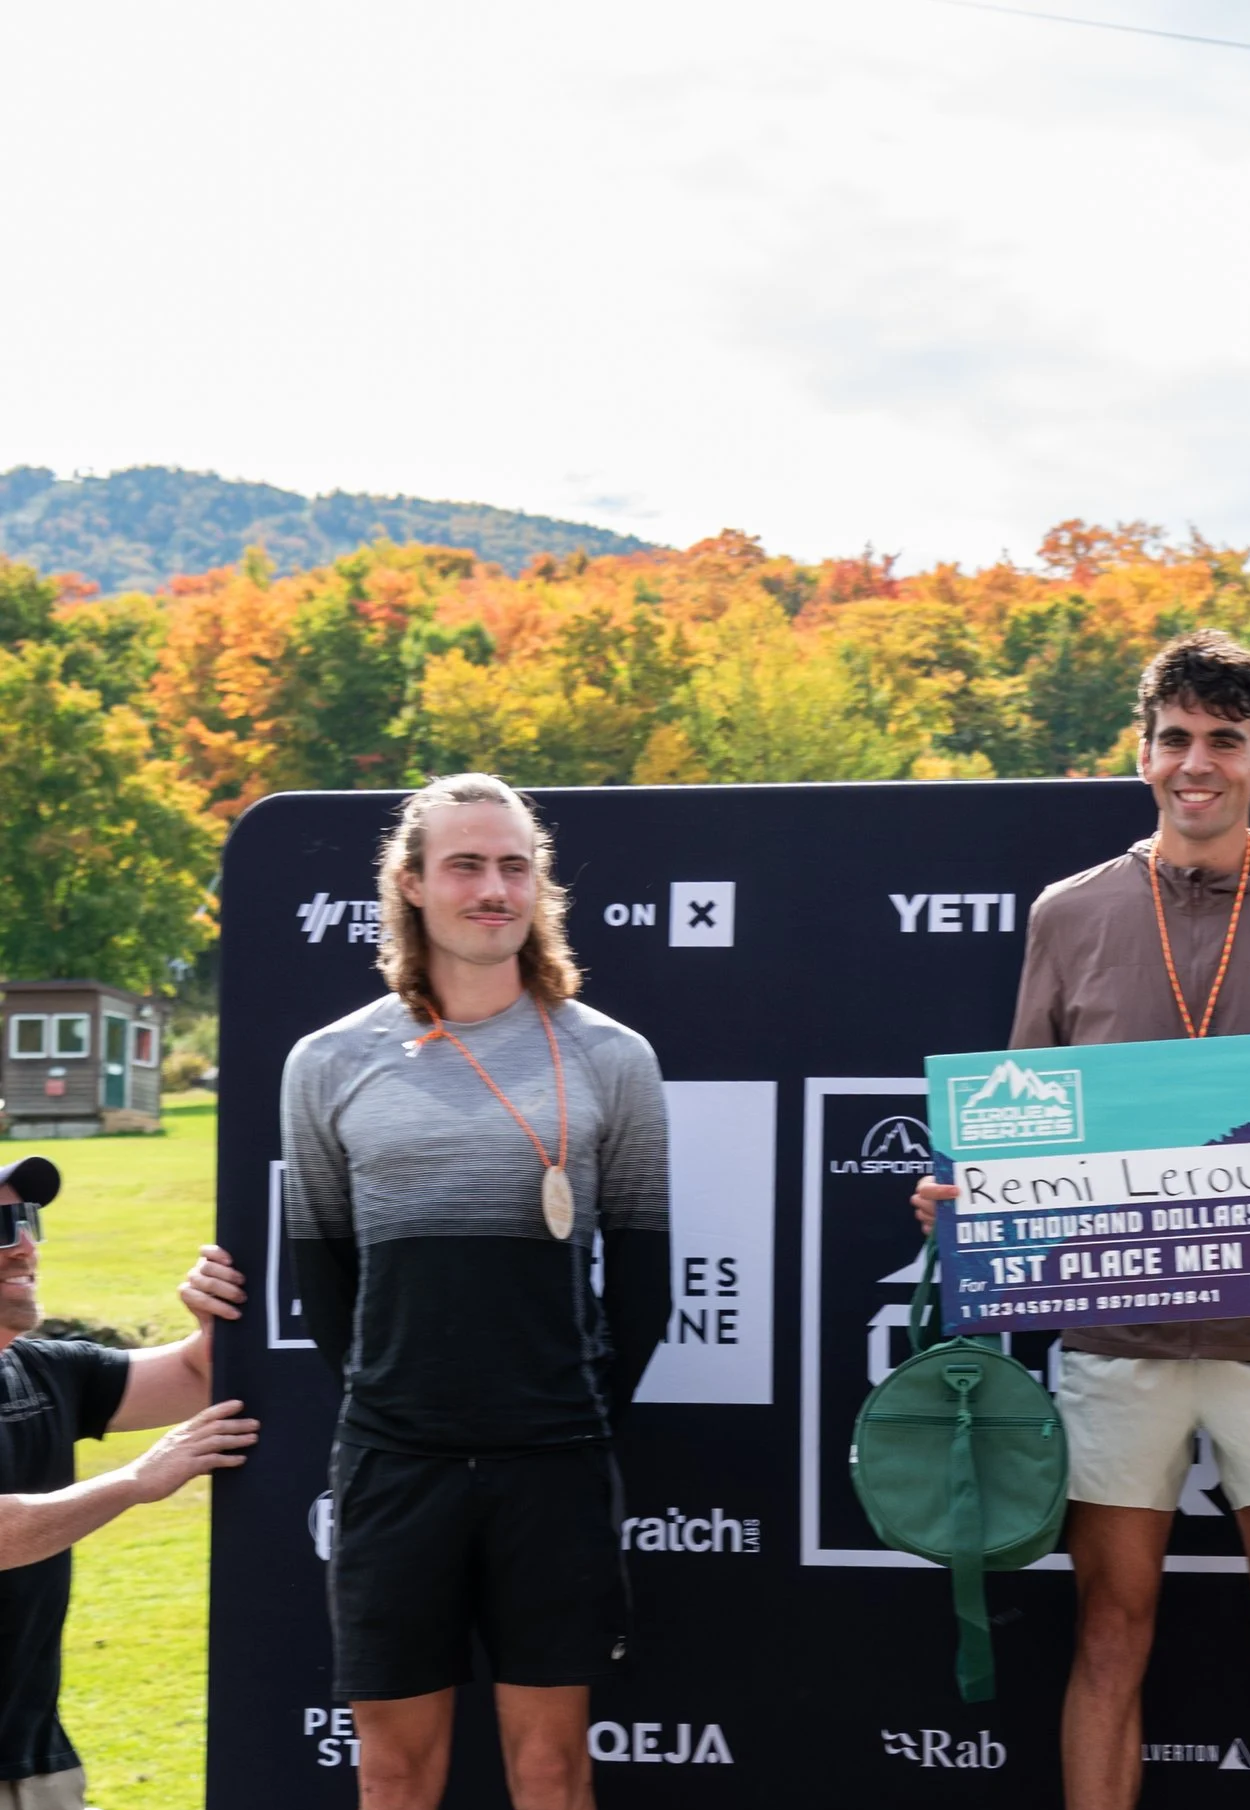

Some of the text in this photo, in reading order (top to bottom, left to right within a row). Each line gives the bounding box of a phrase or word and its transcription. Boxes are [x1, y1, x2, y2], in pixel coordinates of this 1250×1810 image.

[604, 904, 656, 926] ON
[889, 894, 1015, 932] YETI
[960, 1105, 1043, 1124] CIRQUE
[960, 1118, 1073, 1141] SERIES
[830, 1160, 935, 1174] LA SPORT
[965, 1160, 1094, 1205] Remi
[956, 1220, 1005, 1244] ONE
[1014, 1211, 1143, 1240] THOUSAND
[959, 1242, 1243, 1293] For 1ST PLACE MEN
[979, 1298, 1089, 1318] 123456789
[621, 1507, 743, 1552] ratch
[921, 1729, 1006, 1769] Rab
[1141, 1744, 1219, 1762] LVERTON
